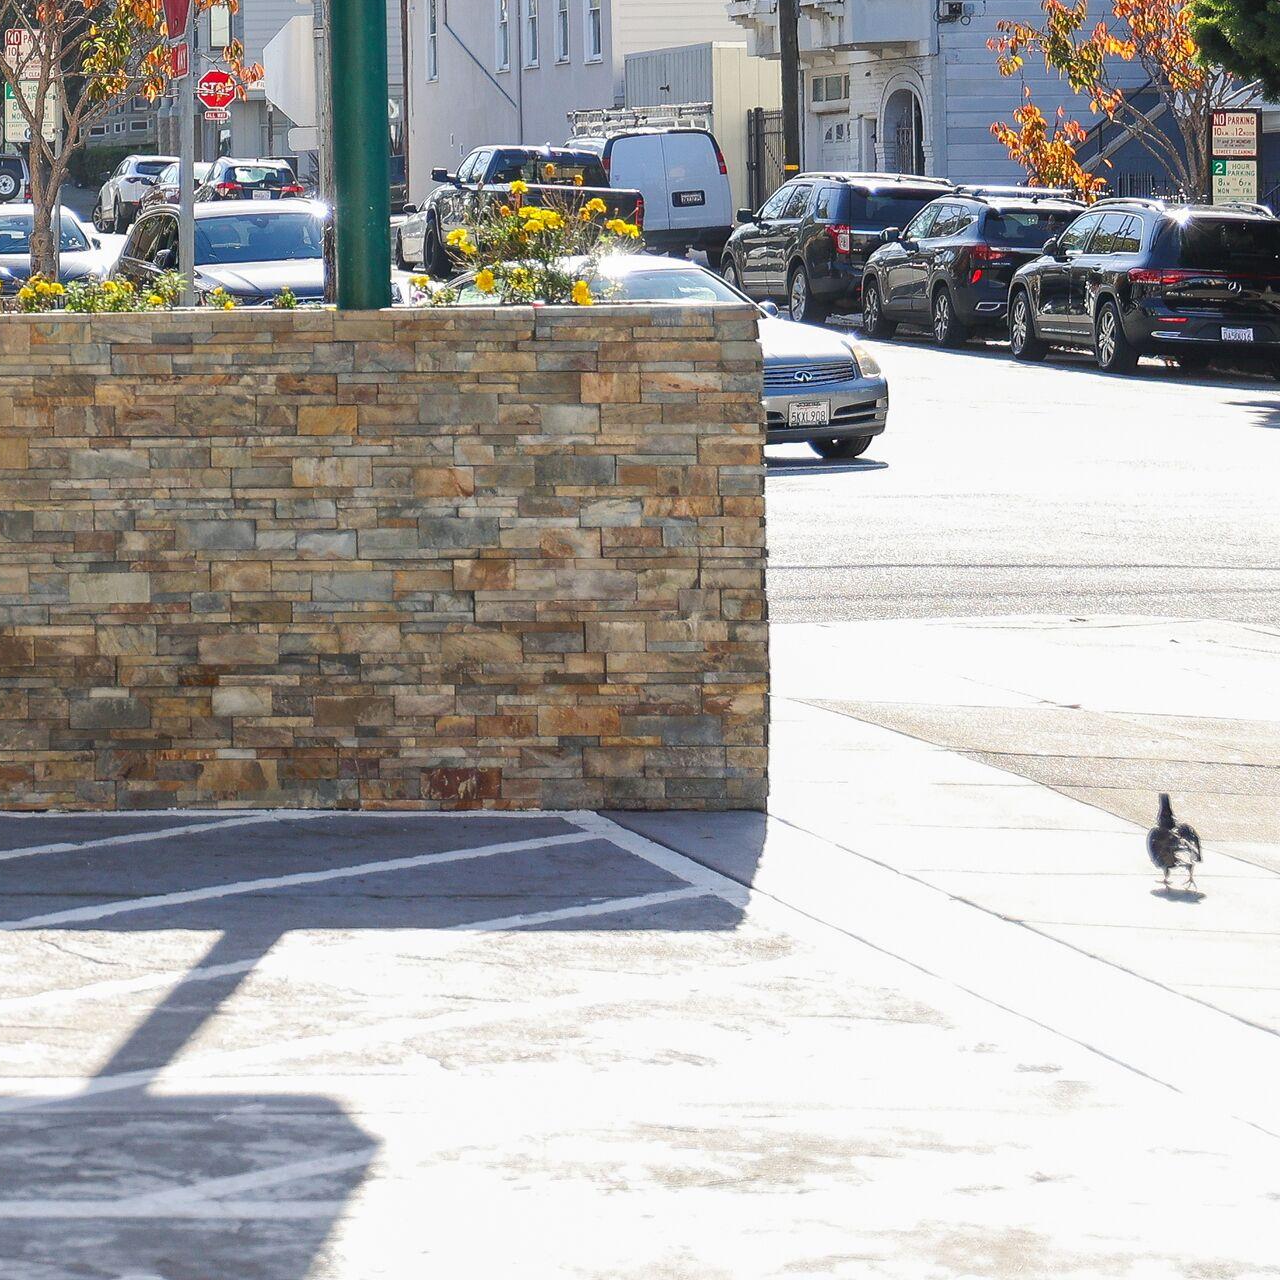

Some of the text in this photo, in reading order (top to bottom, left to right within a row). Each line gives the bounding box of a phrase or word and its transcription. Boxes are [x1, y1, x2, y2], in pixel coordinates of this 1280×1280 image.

[1213, 113, 1255, 125] NO PARKING
[1215, 162, 1223, 174] 2
